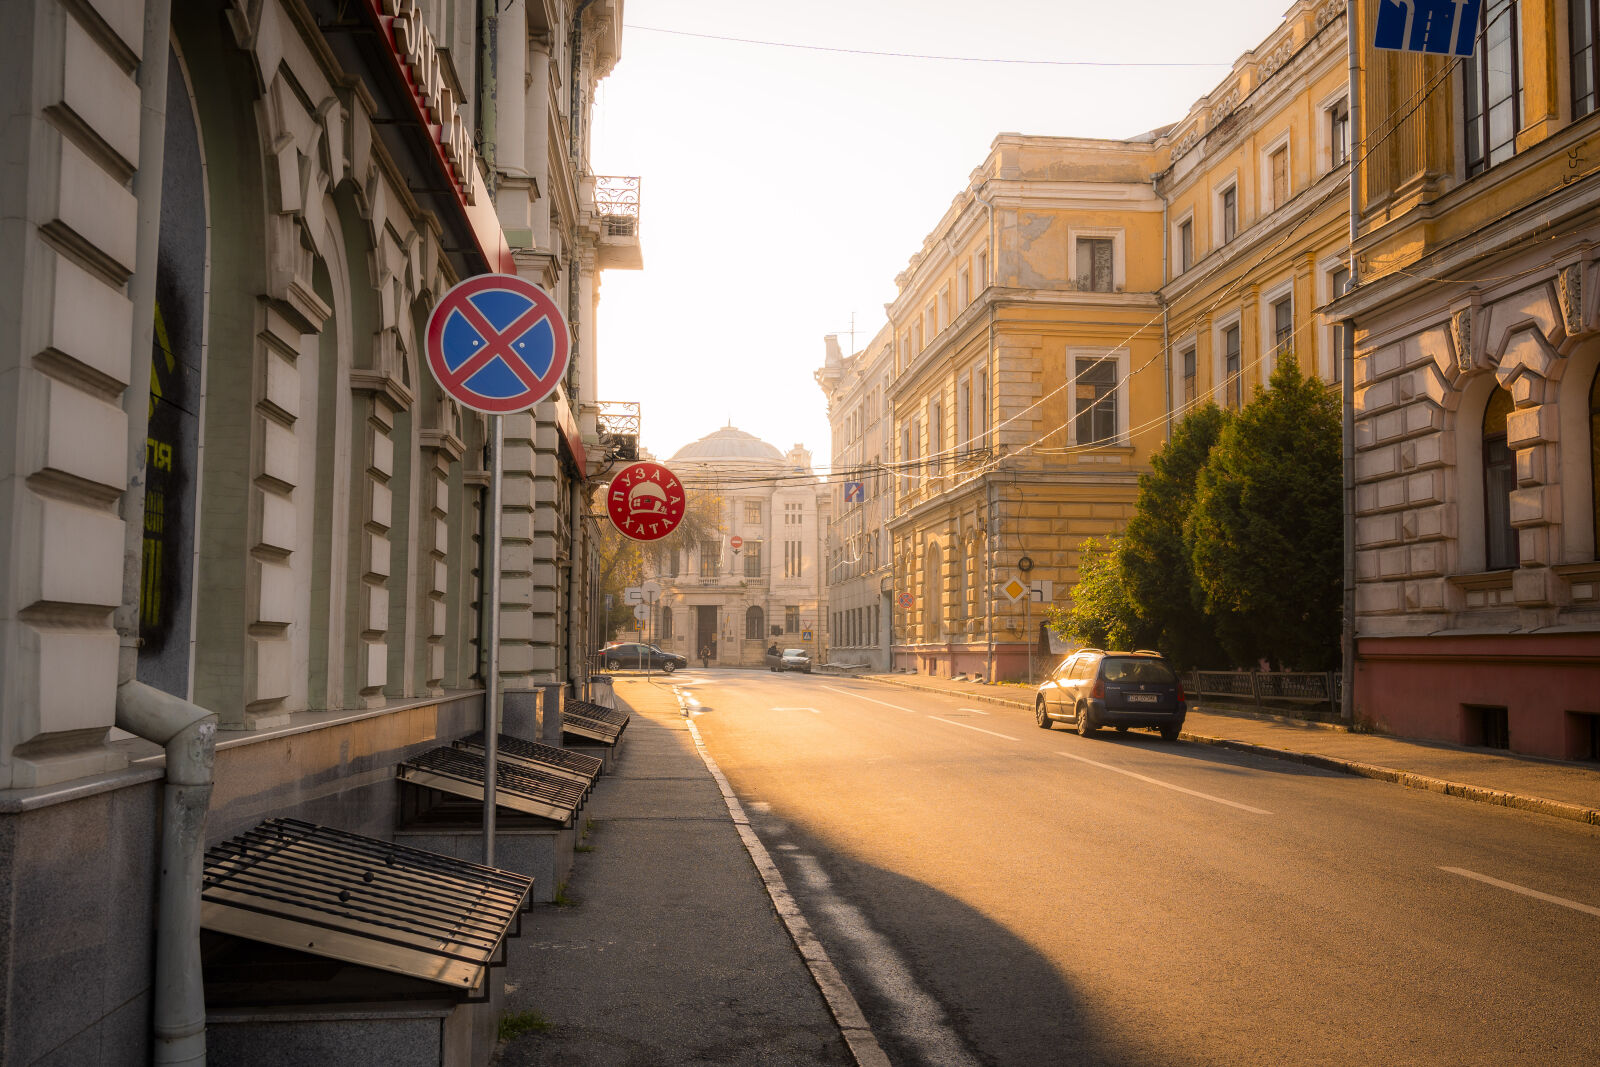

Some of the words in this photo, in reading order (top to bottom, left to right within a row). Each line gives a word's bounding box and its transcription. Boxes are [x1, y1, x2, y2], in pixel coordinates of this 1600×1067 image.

[387, 0, 443, 125] ЗАТА
[441, 88, 477, 206] ХАТА
[612, 467, 681, 506] ПУЗАТА
[621, 515, 674, 535] ХАТА
